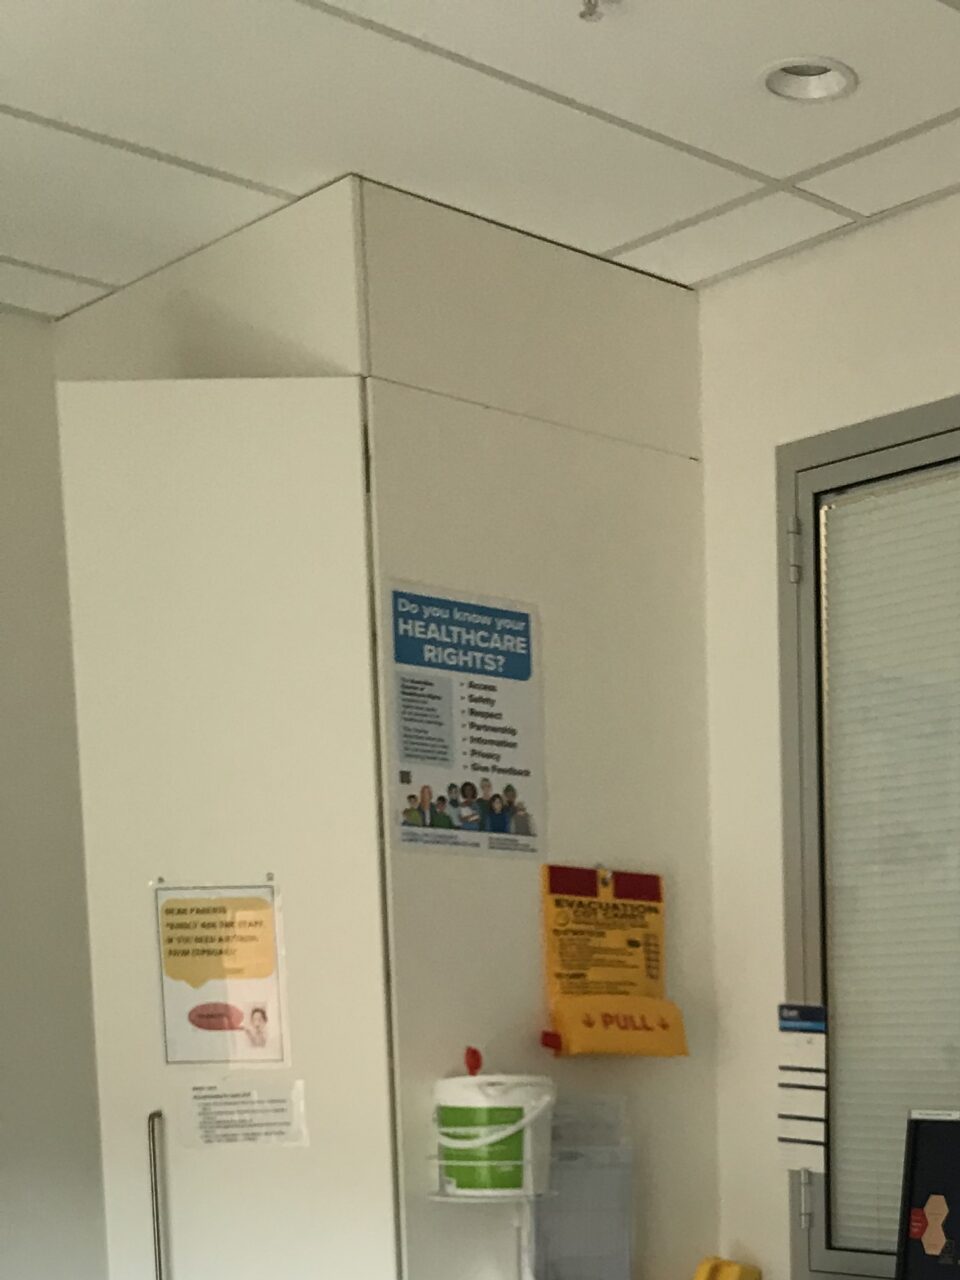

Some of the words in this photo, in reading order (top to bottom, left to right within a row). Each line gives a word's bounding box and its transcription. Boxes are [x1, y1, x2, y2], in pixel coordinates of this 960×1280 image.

[398, 598, 419, 614] Do
[422, 605, 450, 619] you
[453, 607, 494, 625] know
[495, 617, 526, 630] your
[398, 618, 528, 654] HEALTHCARE
[423, 644, 506, 672] RIGHTS?
[468, 681, 498, 692] Access
[468, 694, 497, 708] Safety
[468, 708, 503, 720] Respect
[468, 721, 518, 736] Partnership
[469, 736, 518, 748] Information
[470, 749, 501, 762] Privacy
[554, 898, 660, 914] EVACUATION
[601, 1013, 654, 1032] PULL
